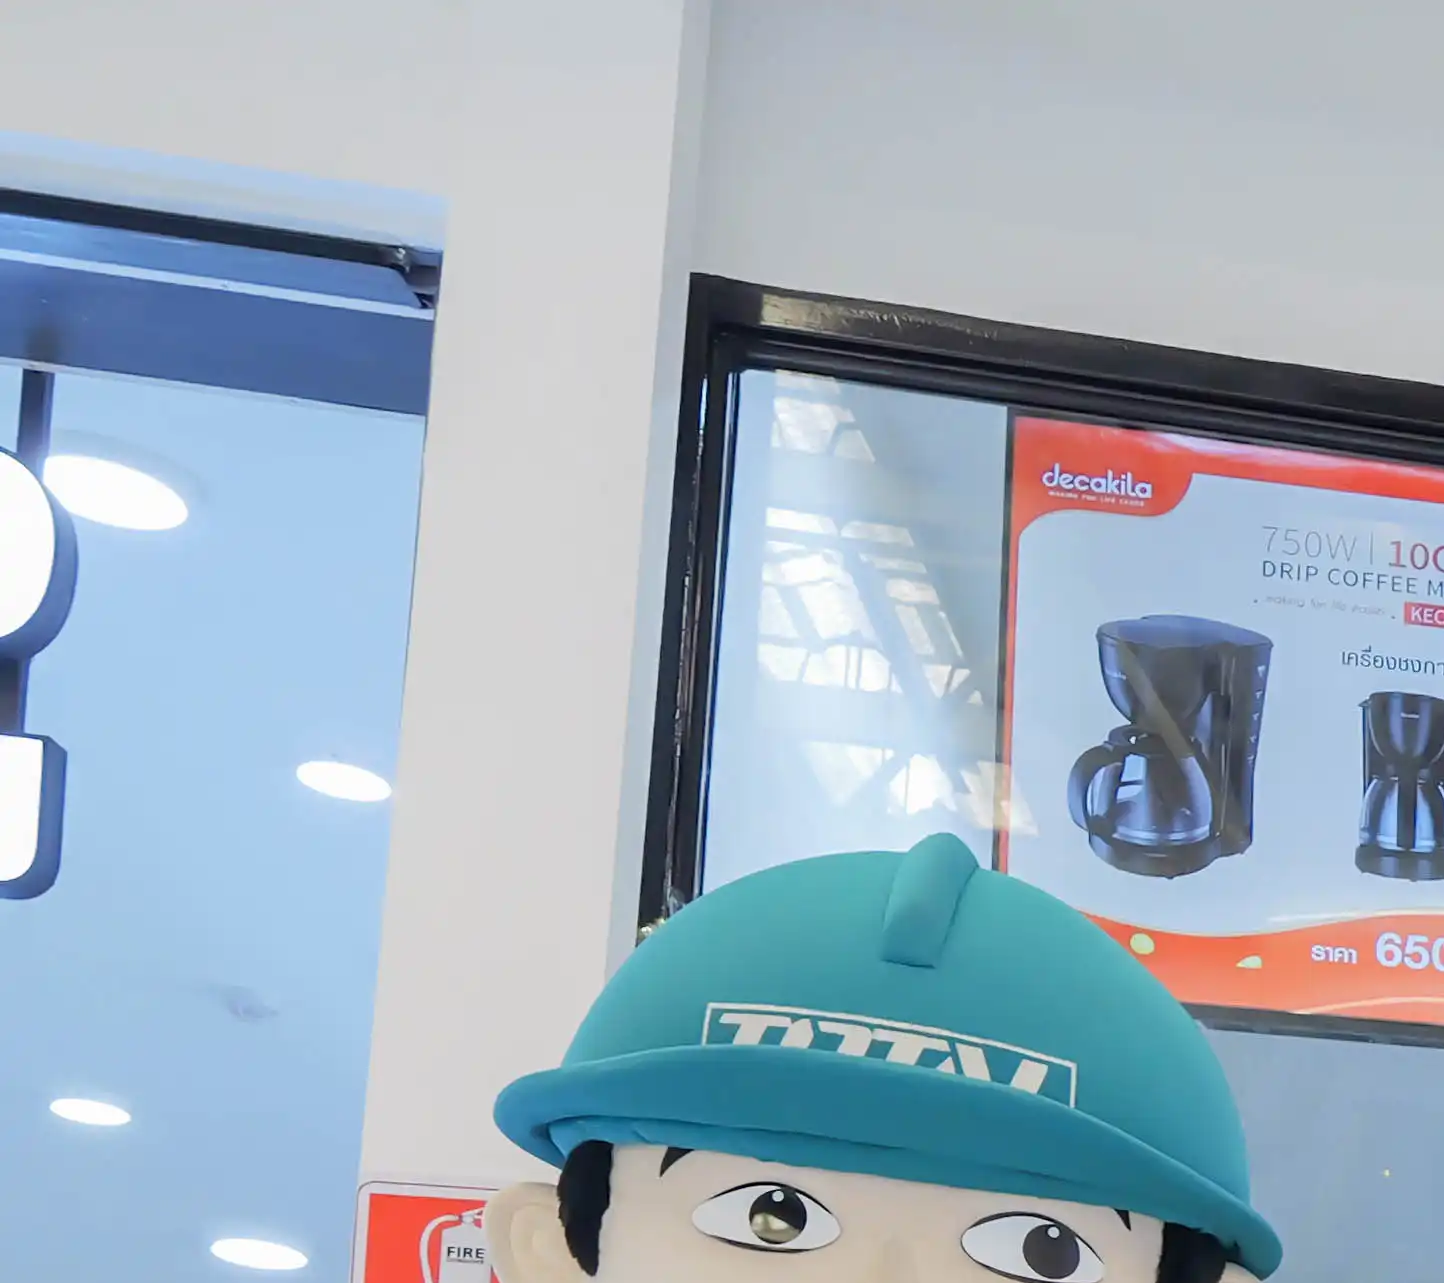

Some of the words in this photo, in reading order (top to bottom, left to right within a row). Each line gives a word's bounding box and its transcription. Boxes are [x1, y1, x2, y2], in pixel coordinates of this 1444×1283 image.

[1042, 463, 1152, 498] decakila
[1262, 526, 1358, 563] 750W
[1262, 560, 1320, 582] DRIP
[1327, 567, 1418, 595] COFFEE
[1311, 943, 1357, 965] ราคา
[447, 1246, 486, 1259] FIRE
